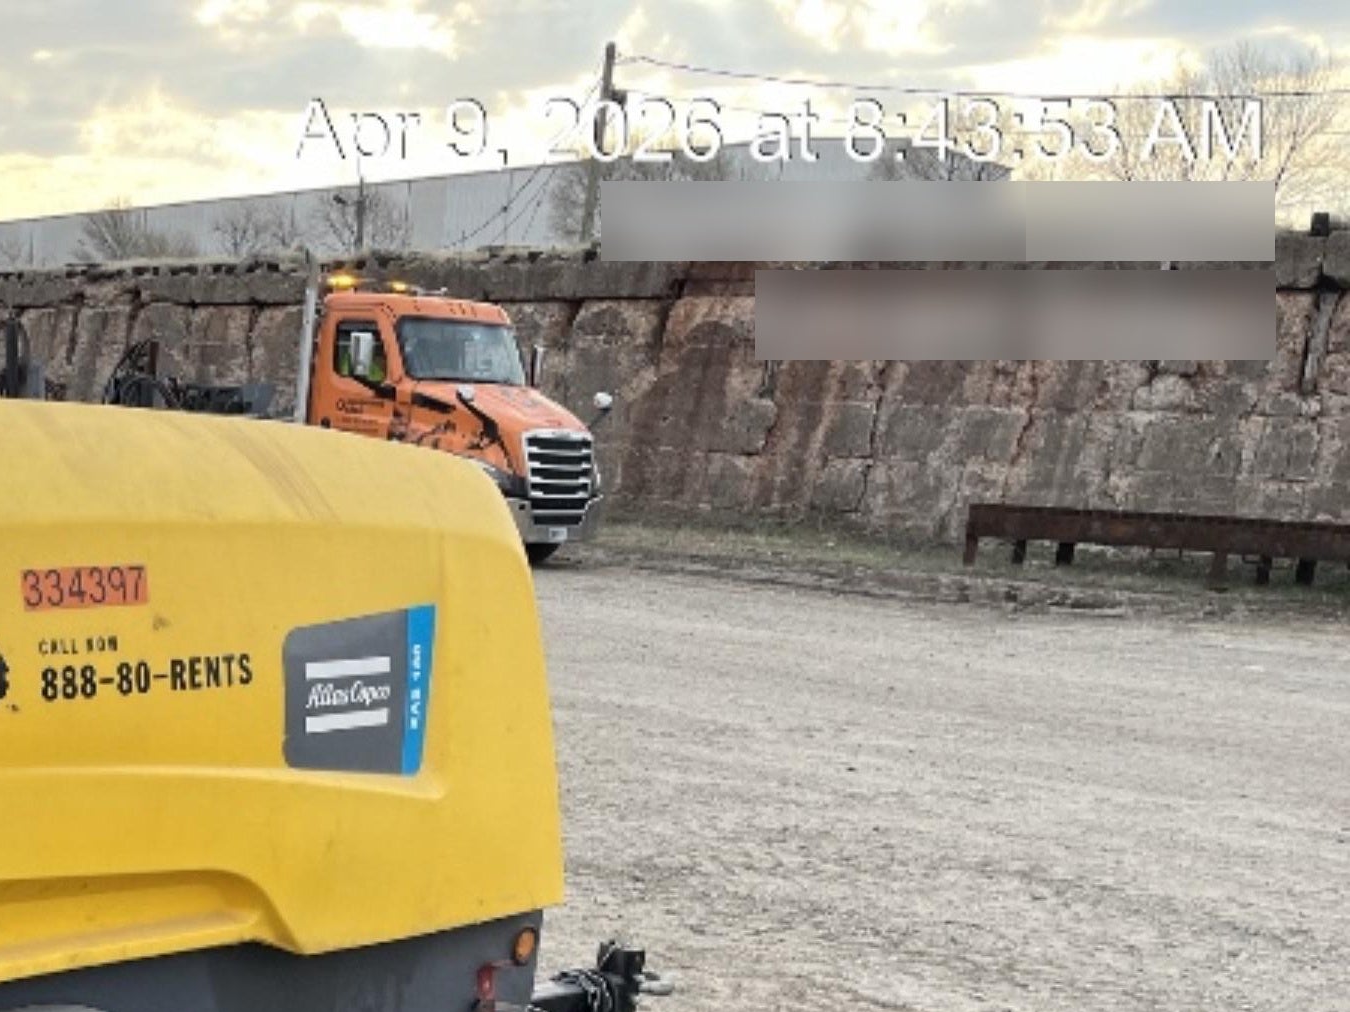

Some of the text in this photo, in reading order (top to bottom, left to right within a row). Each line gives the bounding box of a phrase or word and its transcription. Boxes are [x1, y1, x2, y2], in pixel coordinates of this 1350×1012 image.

[22, 565, 145, 608] 334397
[40, 653, 253, 702] 888-80-RENTS
[305, 680, 391, 709] Atlas Copco
